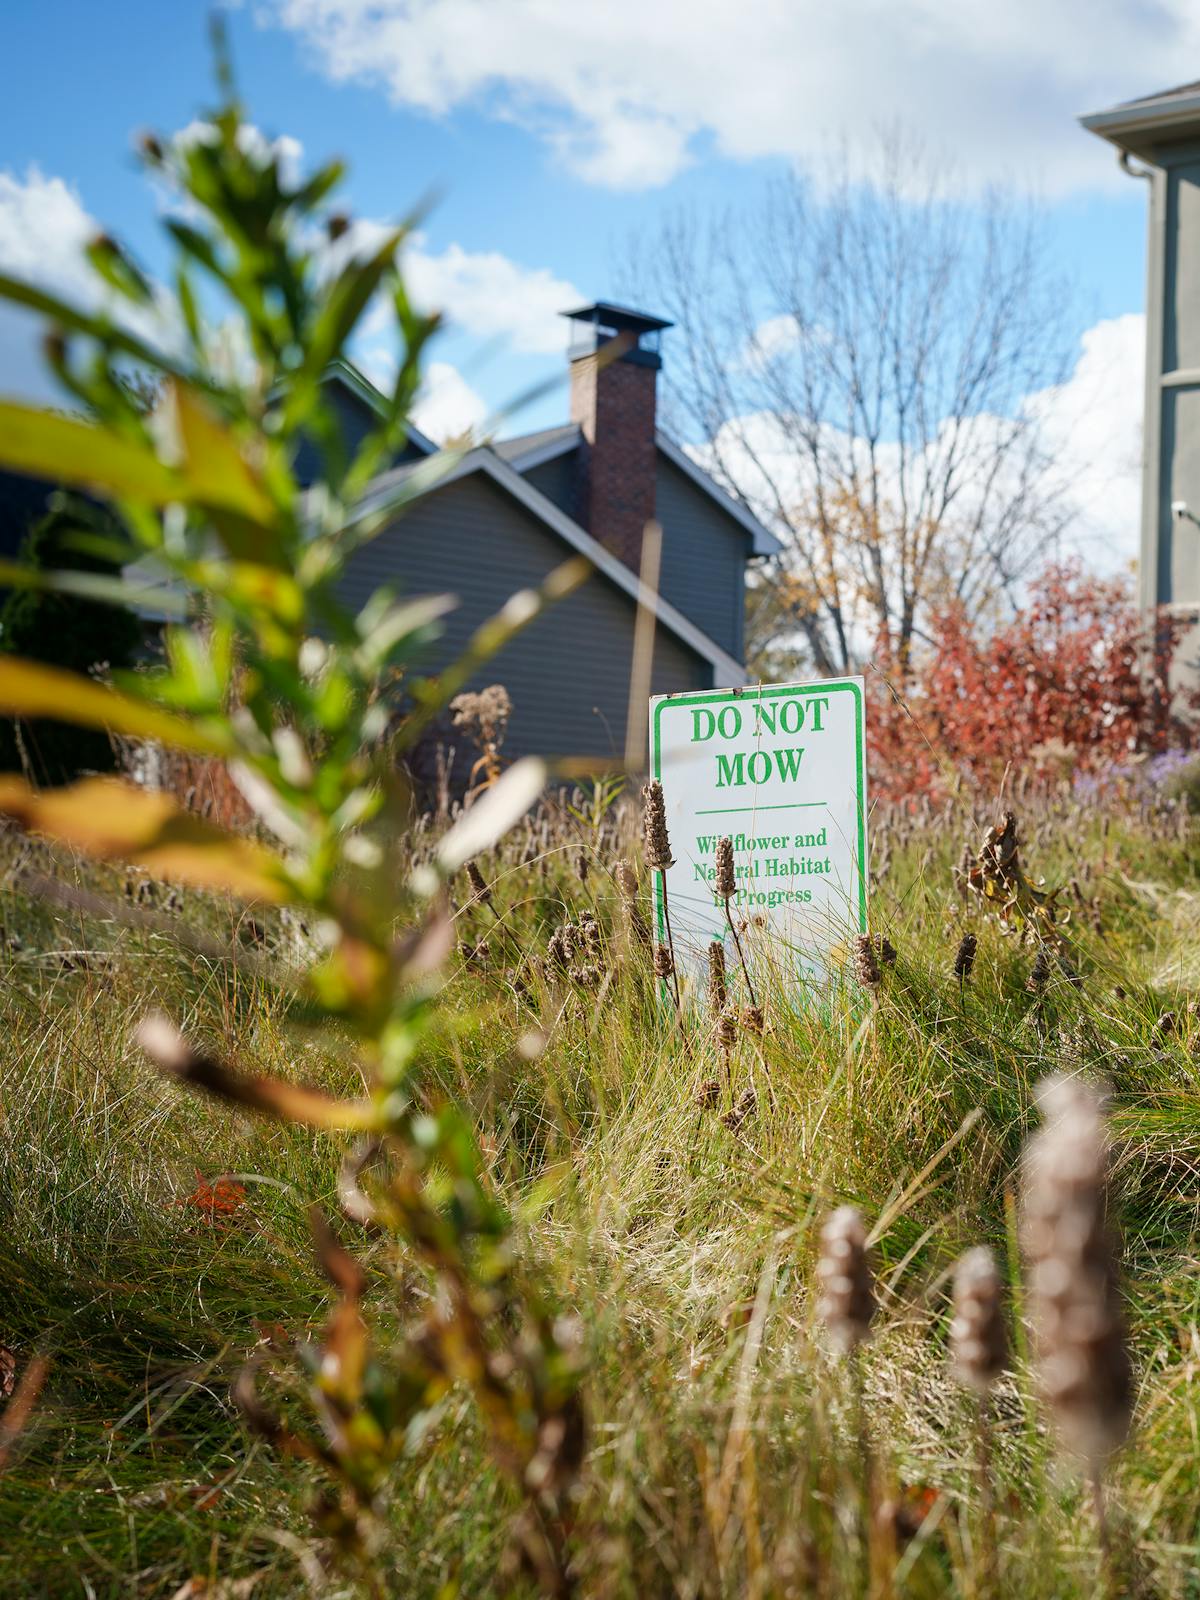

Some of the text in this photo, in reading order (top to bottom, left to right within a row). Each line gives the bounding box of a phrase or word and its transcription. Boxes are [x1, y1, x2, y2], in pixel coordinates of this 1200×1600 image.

[690, 697, 829, 742] DO NOT
[715, 747, 806, 788] MOW
[696, 828, 827, 855] Wiflower and
[693, 856, 832, 881] Naral Habitat
[735, 888, 812, 909] Progress
